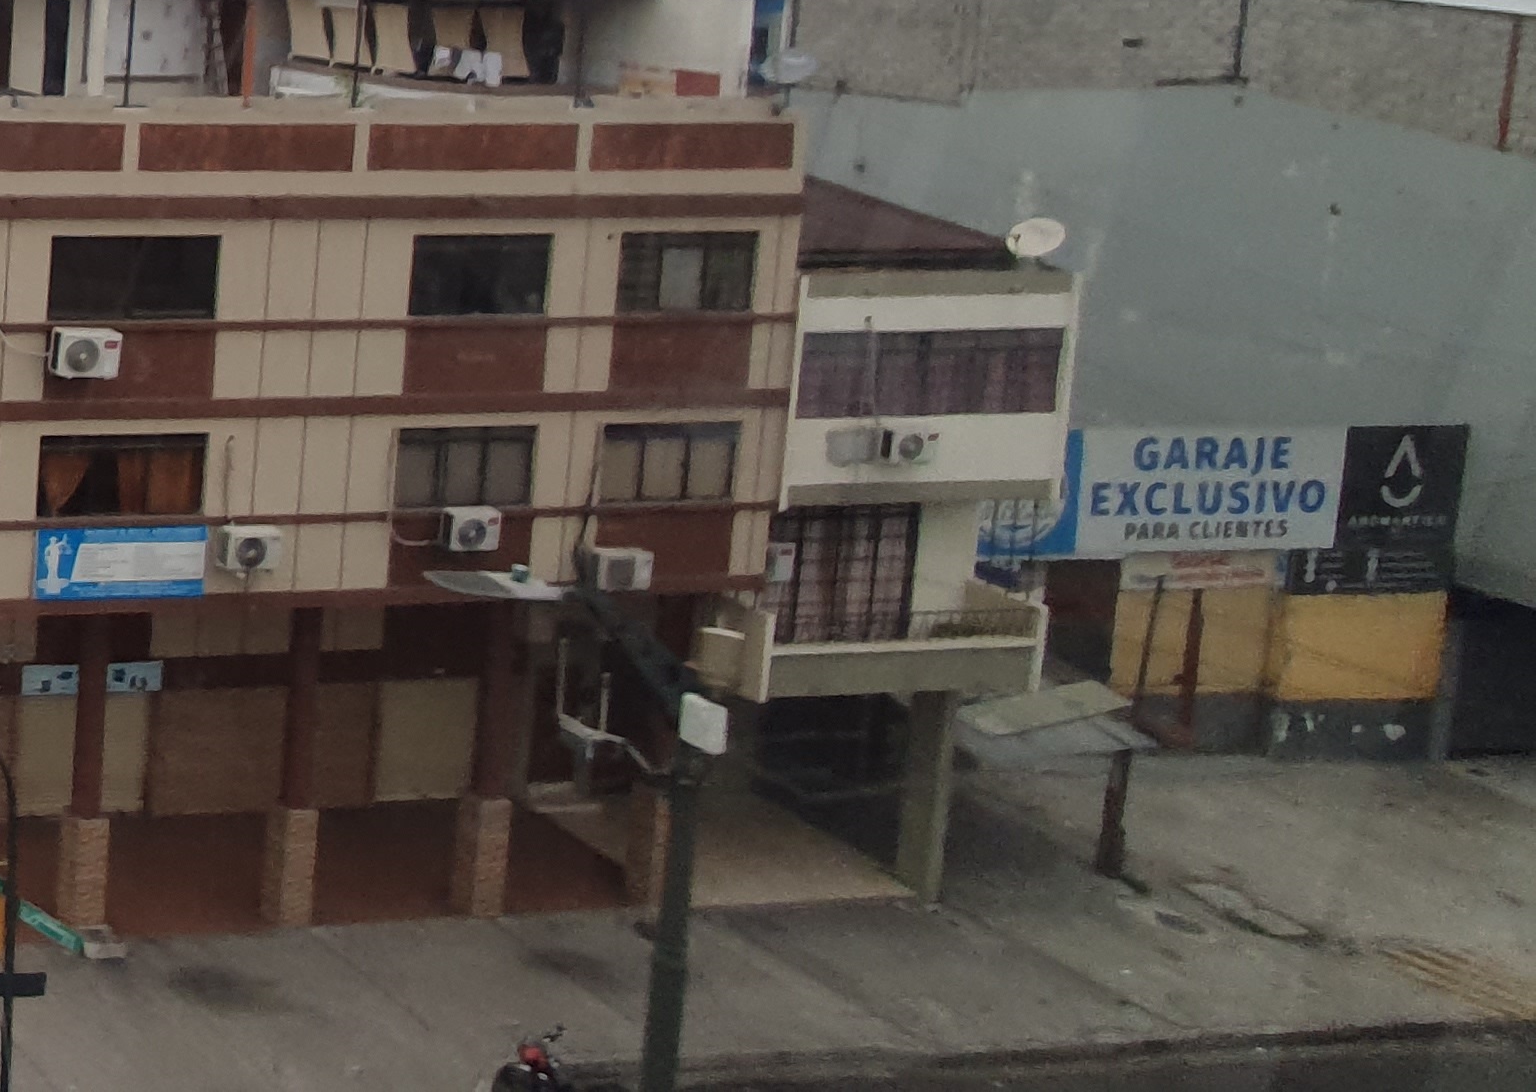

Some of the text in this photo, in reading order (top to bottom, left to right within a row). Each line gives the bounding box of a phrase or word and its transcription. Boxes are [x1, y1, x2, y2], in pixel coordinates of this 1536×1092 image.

[1133, 436, 1292, 475] GARAJE
[1090, 479, 1326, 517] EXCLUSIVO
[1124, 518, 1288, 541] PARA CLIENTES
